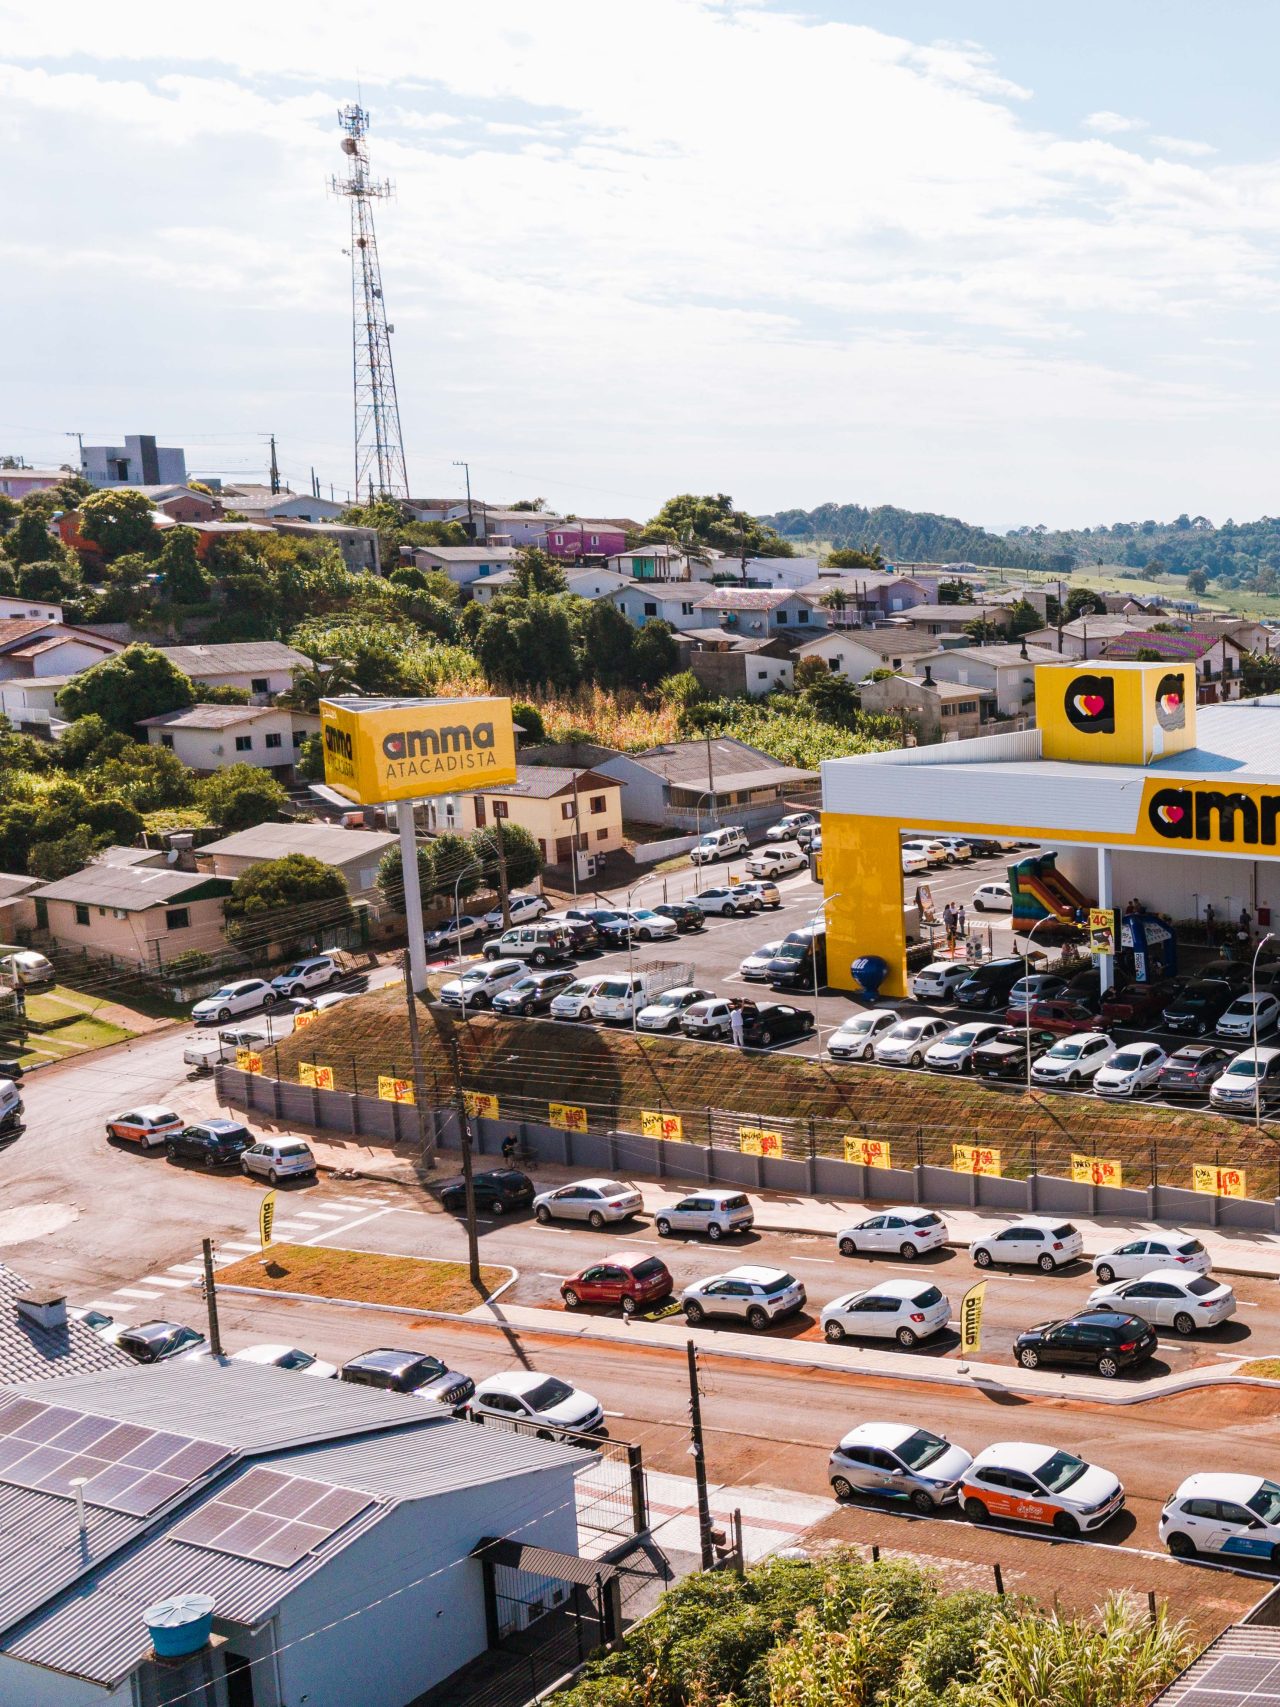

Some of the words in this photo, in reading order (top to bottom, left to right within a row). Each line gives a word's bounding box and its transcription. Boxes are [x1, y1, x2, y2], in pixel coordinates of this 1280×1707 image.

[382, 722, 494, 761] amma
[386, 751, 497, 779] ATACADISTA
[966, 1298, 976, 1345] amma
